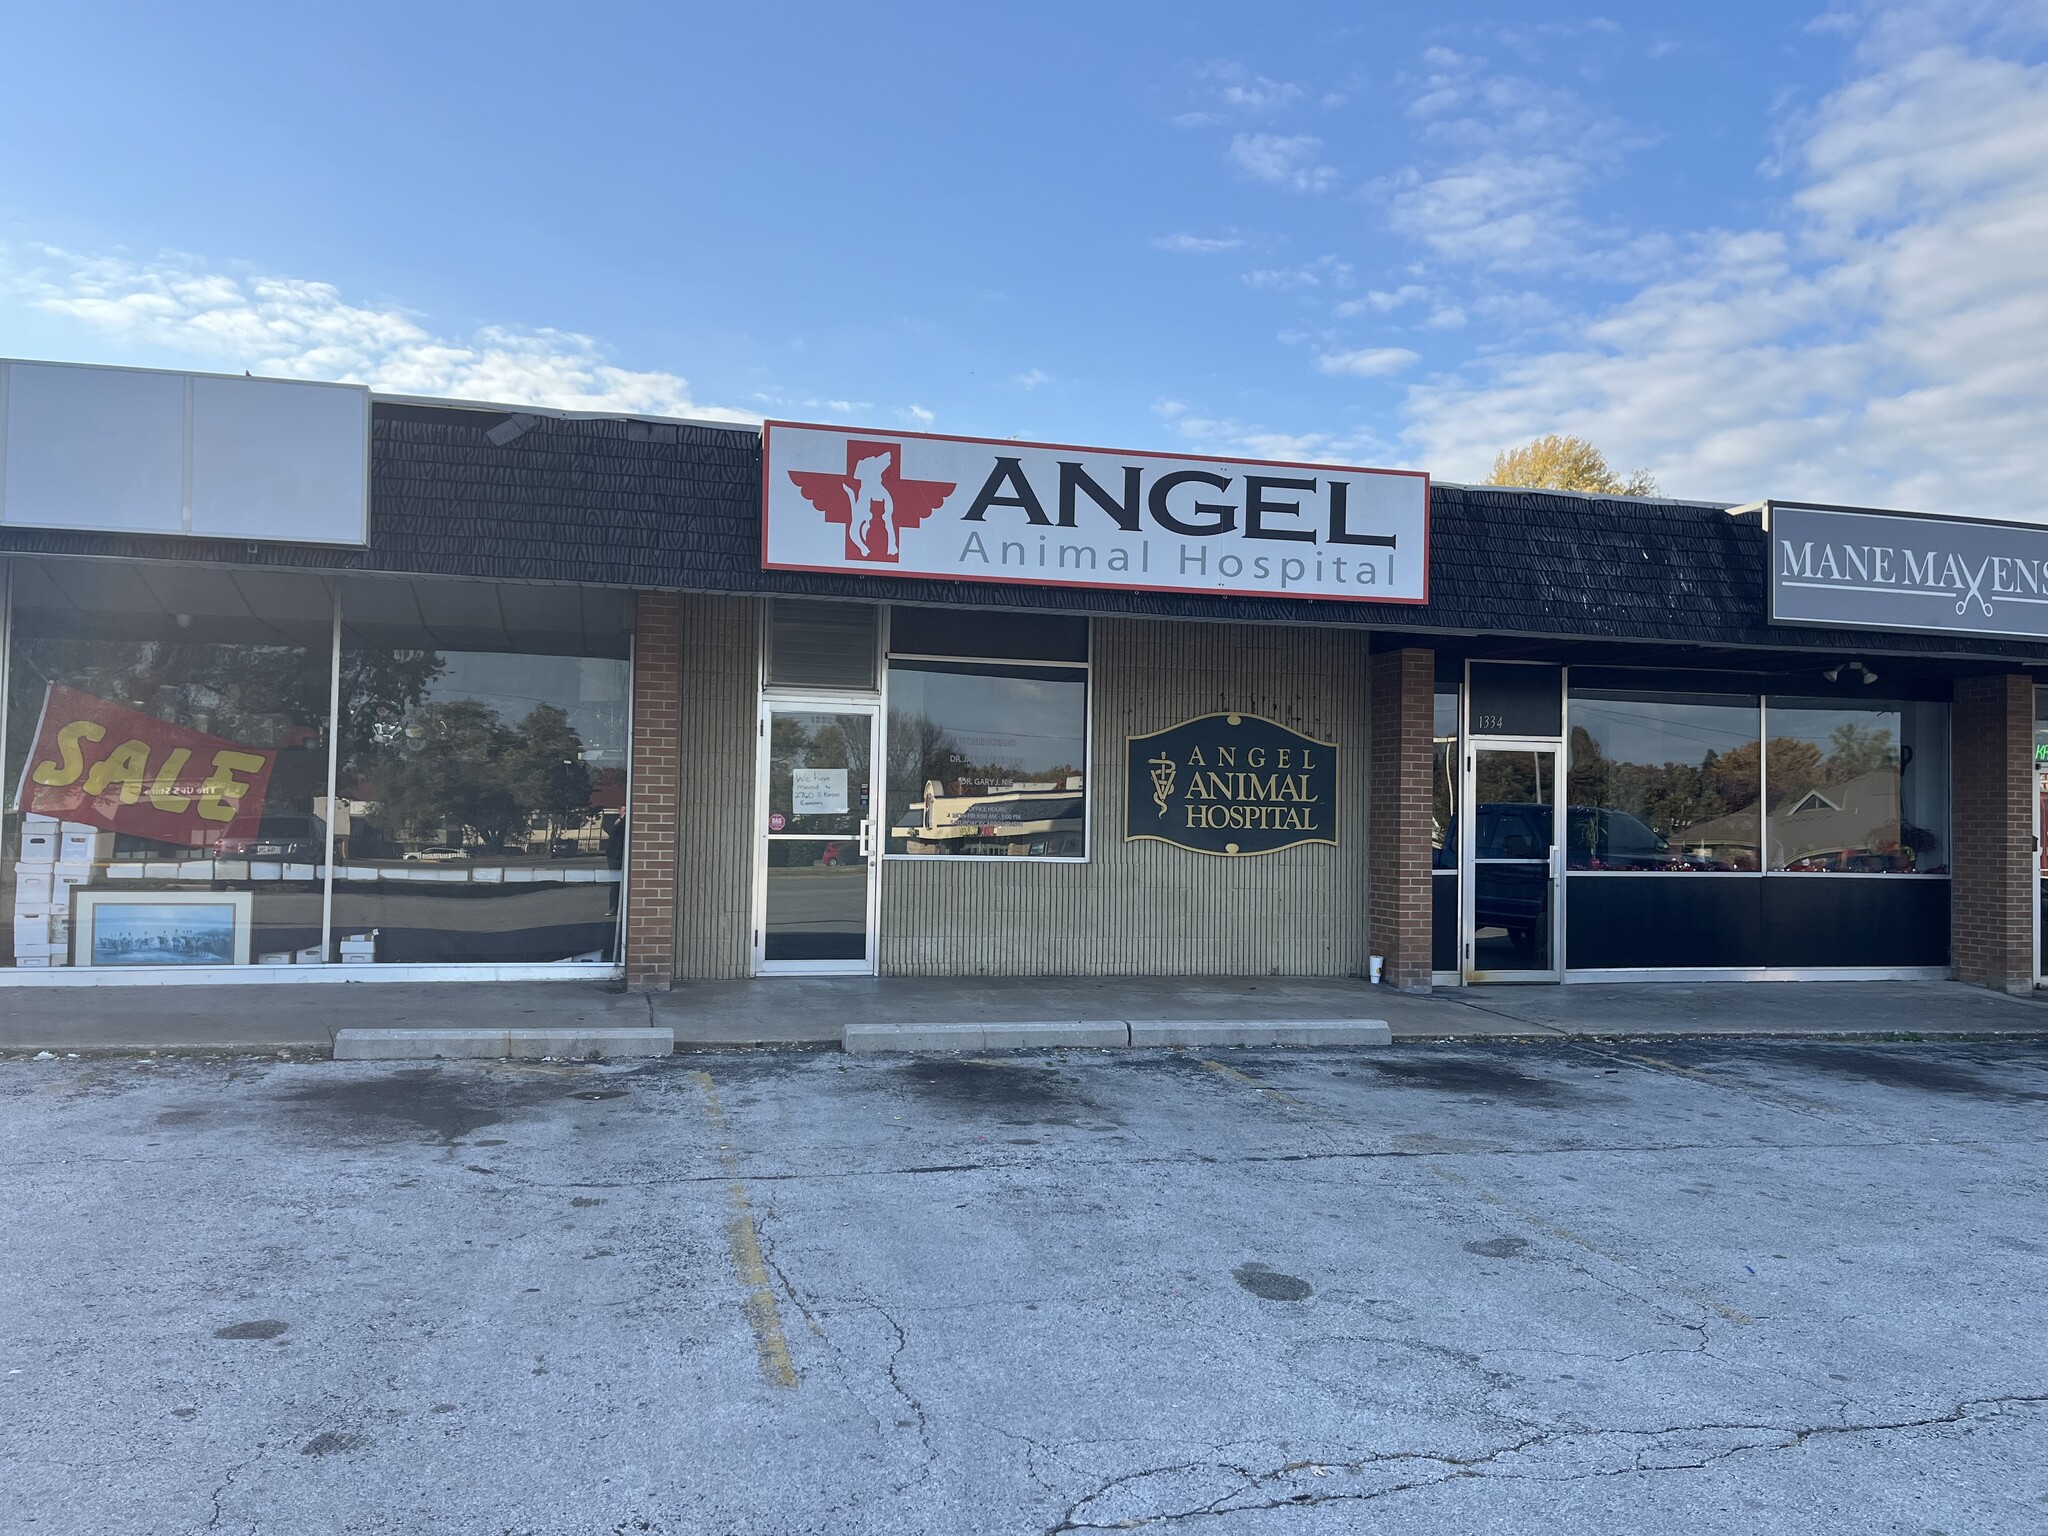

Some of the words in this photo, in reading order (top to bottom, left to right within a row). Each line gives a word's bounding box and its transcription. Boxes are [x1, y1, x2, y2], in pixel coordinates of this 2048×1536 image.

[960, 456, 1398, 550] ANGEL
[958, 530, 1149, 572] Animal
[1180, 544, 1395, 588] Hospital
[1780, 540, 1896, 583] MANE
[1478, 715, 1503, 729] 1334
[32, 720, 267, 823] SALE
[1187, 745, 1316, 770] ANGEL
[795, 773, 810, 783] We
[813, 771, 831, 781] have
[973, 779, 994, 787] GARY
[995, 779, 1001, 787] J.
[1184, 771, 1318, 802] ANIMAL
[1185, 804, 1319, 831] HOSPITAL
